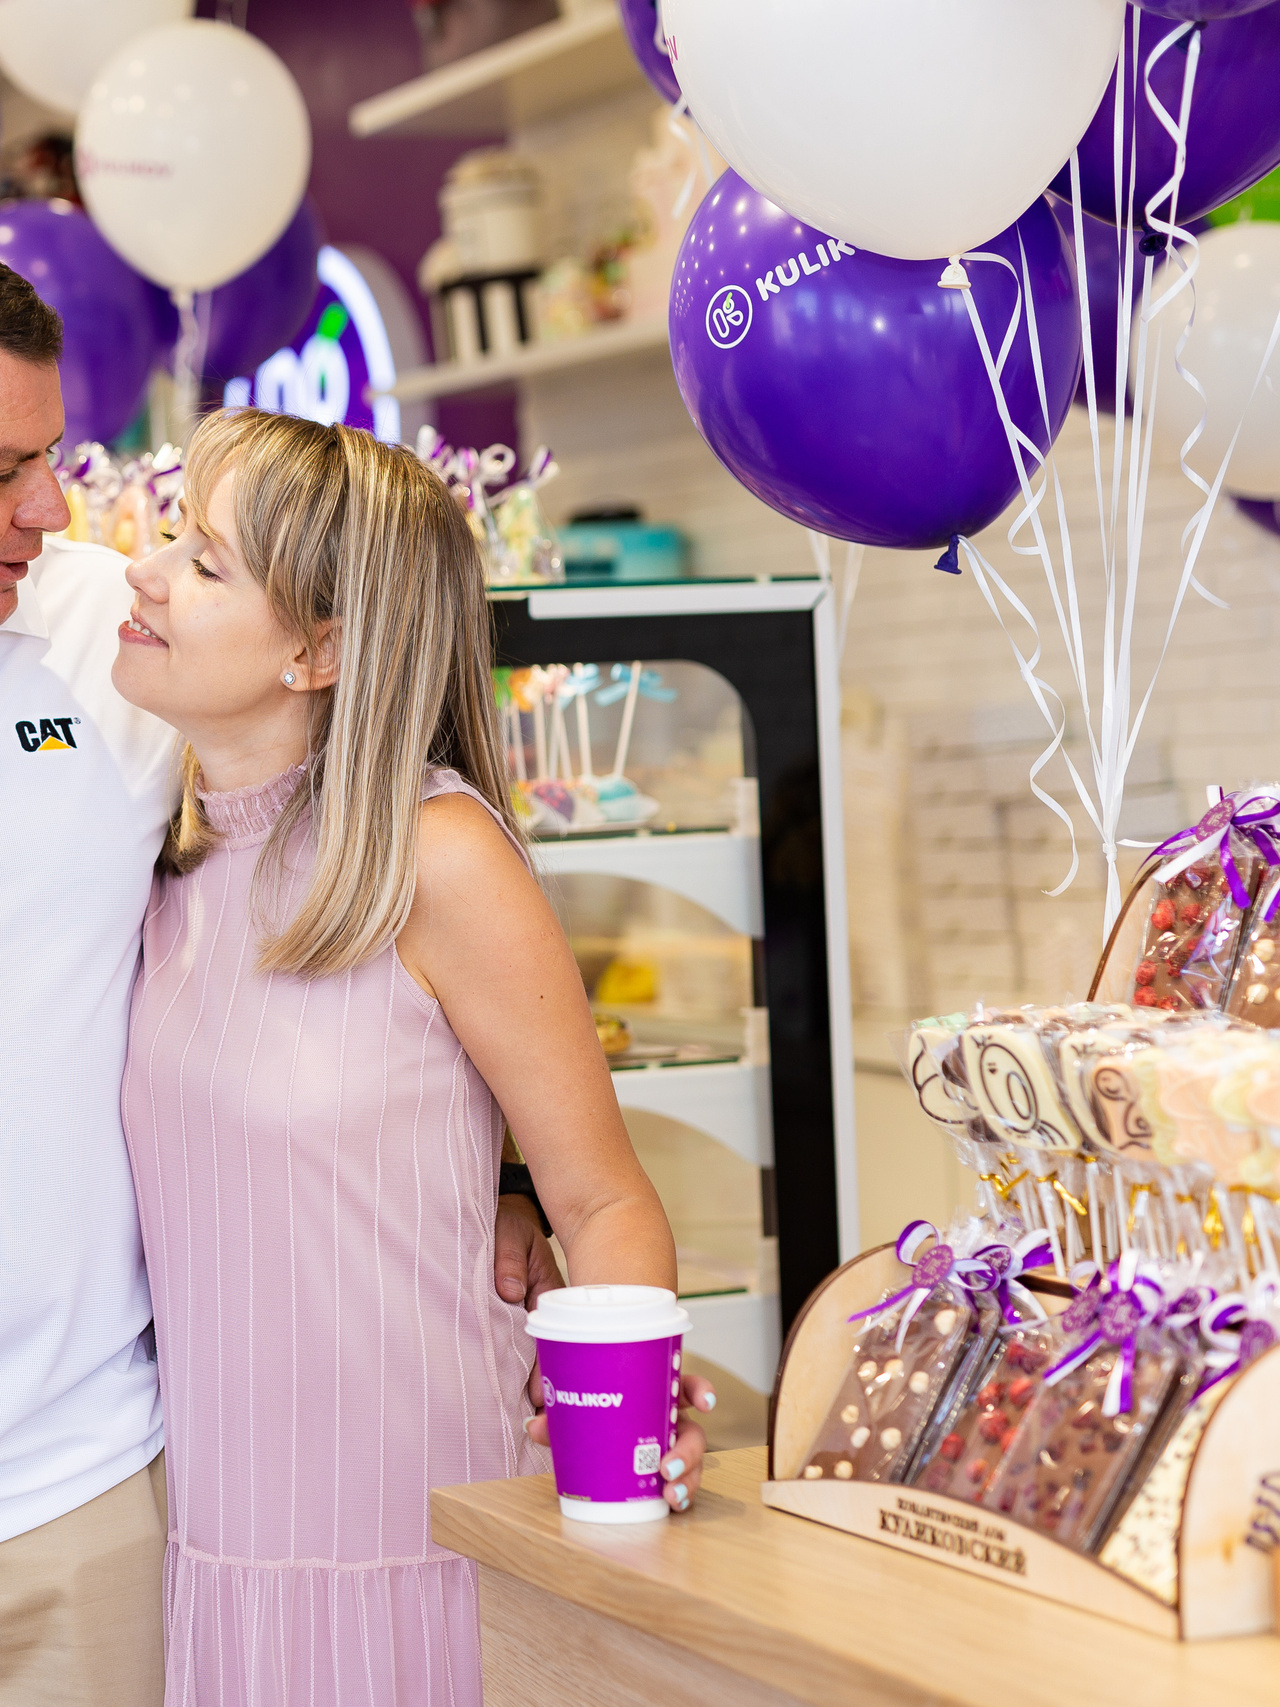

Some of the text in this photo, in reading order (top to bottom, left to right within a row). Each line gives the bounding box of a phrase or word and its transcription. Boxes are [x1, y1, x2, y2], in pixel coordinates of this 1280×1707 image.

[755, 239, 856, 302] KULIK
[15, 717, 78, 752] CAT
[556, 1389, 624, 1408] KULIKOV
